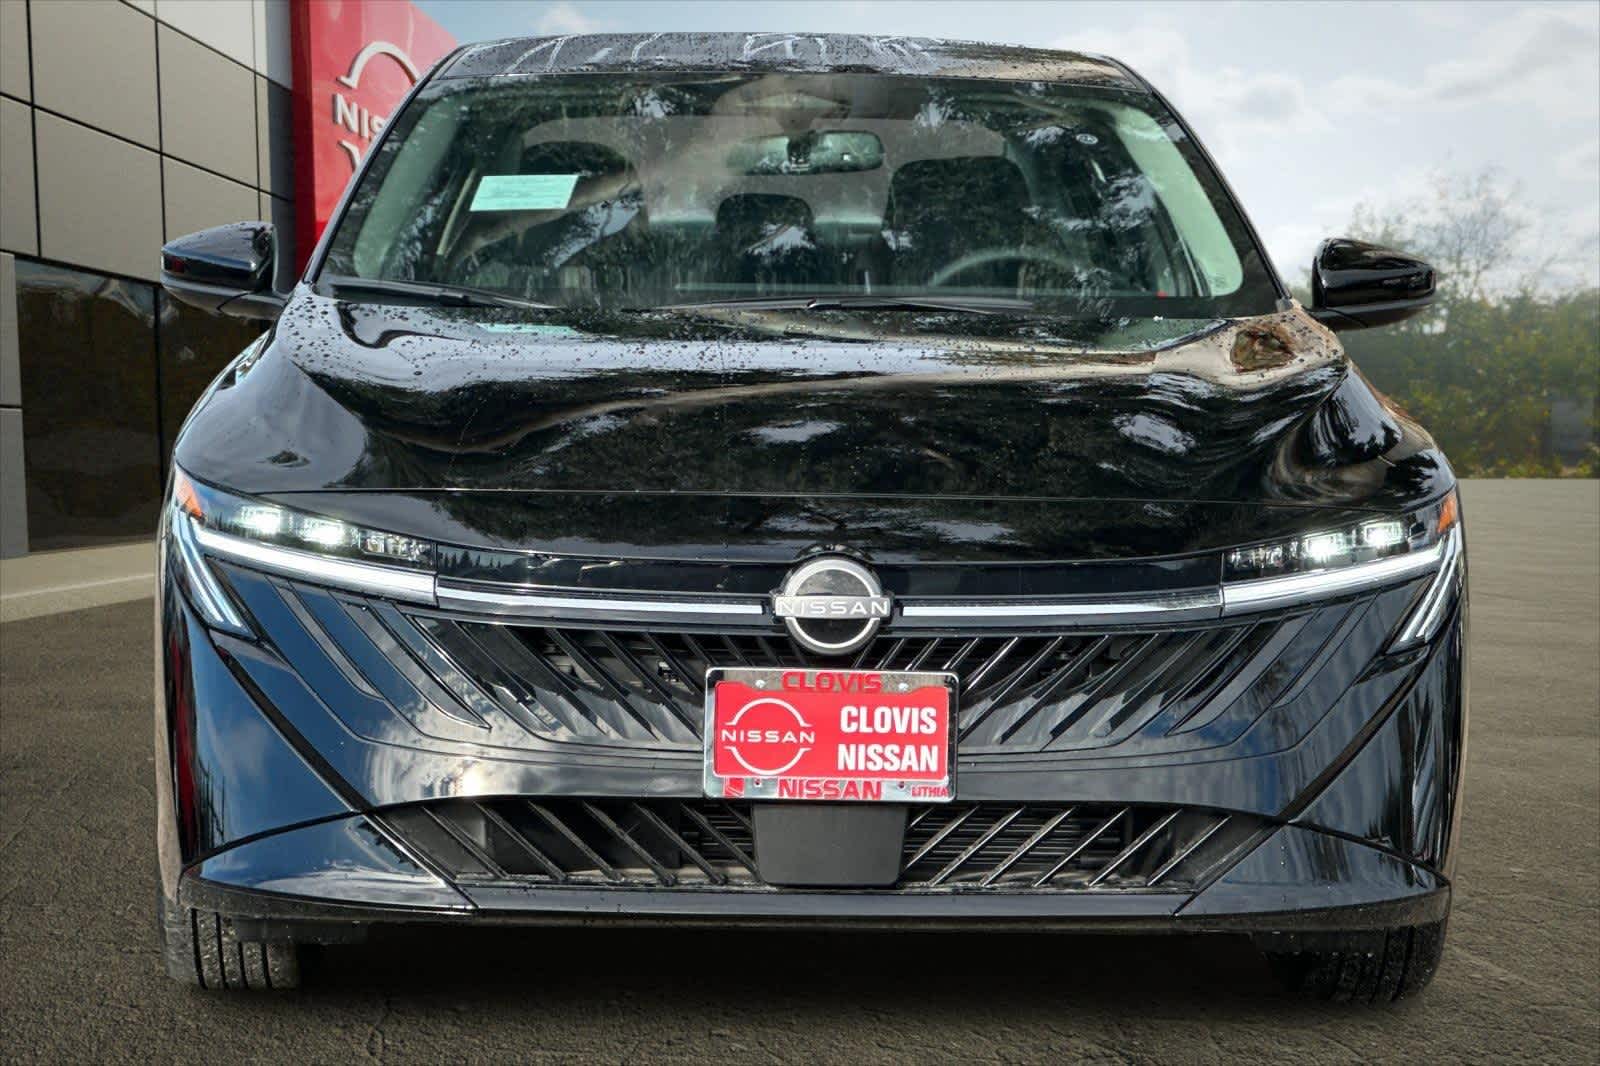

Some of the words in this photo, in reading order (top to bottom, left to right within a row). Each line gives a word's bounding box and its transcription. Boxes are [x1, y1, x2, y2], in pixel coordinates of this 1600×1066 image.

[779, 600, 888, 615] NISSAN
[781, 671, 882, 693] CLOVIS
[840, 706, 937, 734] CLOVIS
[721, 729, 815, 744] NISSAN
[837, 744, 939, 772] NISSAN
[778, 778, 882, 800] NISSAN
[911, 785, 949, 797] LITHIA
